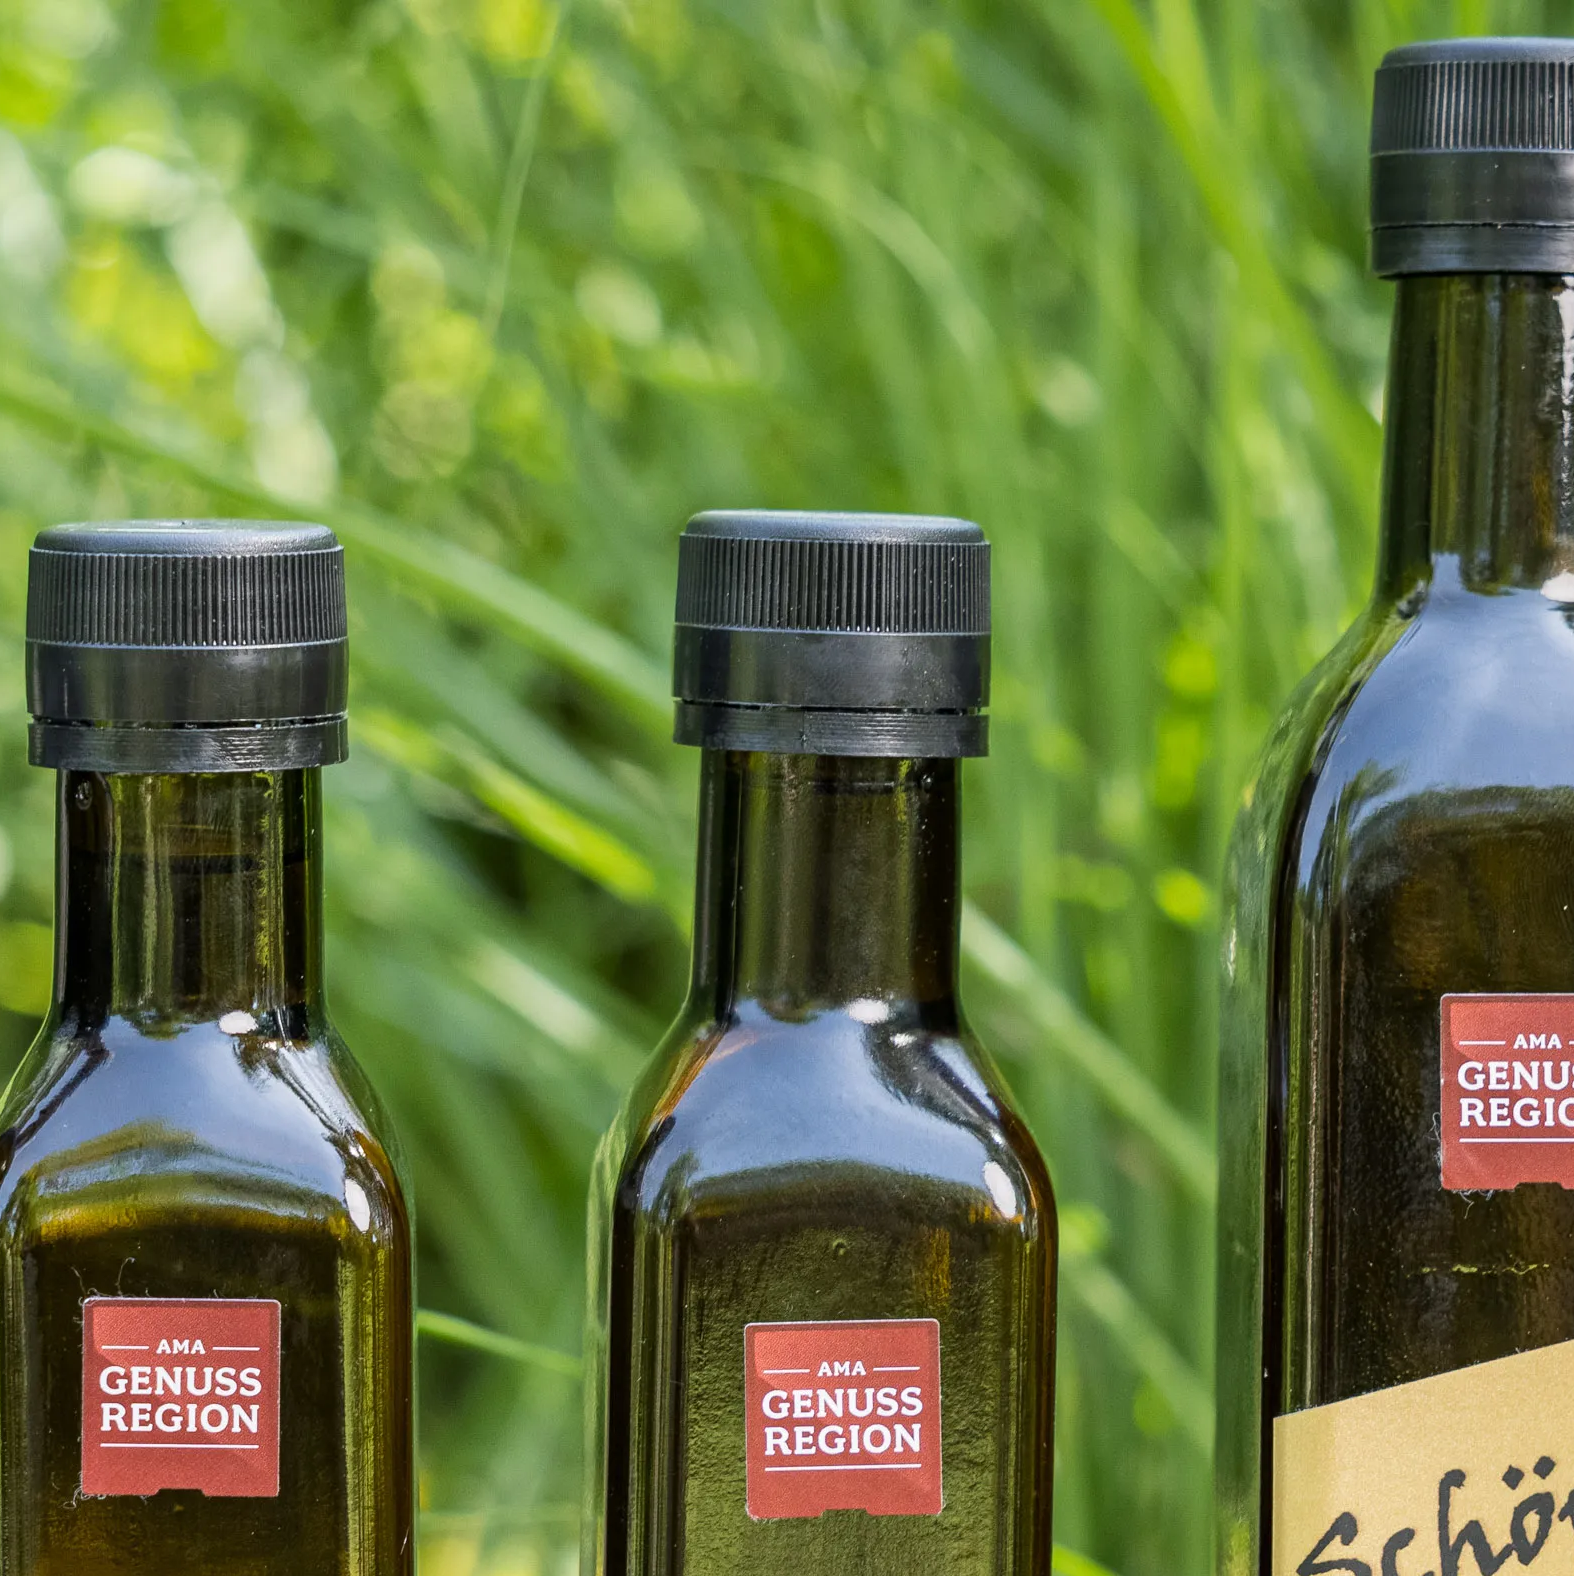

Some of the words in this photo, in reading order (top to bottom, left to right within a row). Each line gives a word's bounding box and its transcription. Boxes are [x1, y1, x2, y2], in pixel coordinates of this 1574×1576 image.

[1514, 1034, 1562, 1049] AMA
[156, 1339, 205, 1354] AMA
[100, 1366, 261, 1396] GENUSS
[818, 1361, 866, 1376] AMA
[101, 1403, 259, 1433] REGION
[762, 1387, 922, 1419] GENUSS
[765, 1424, 921, 1455] REGION
